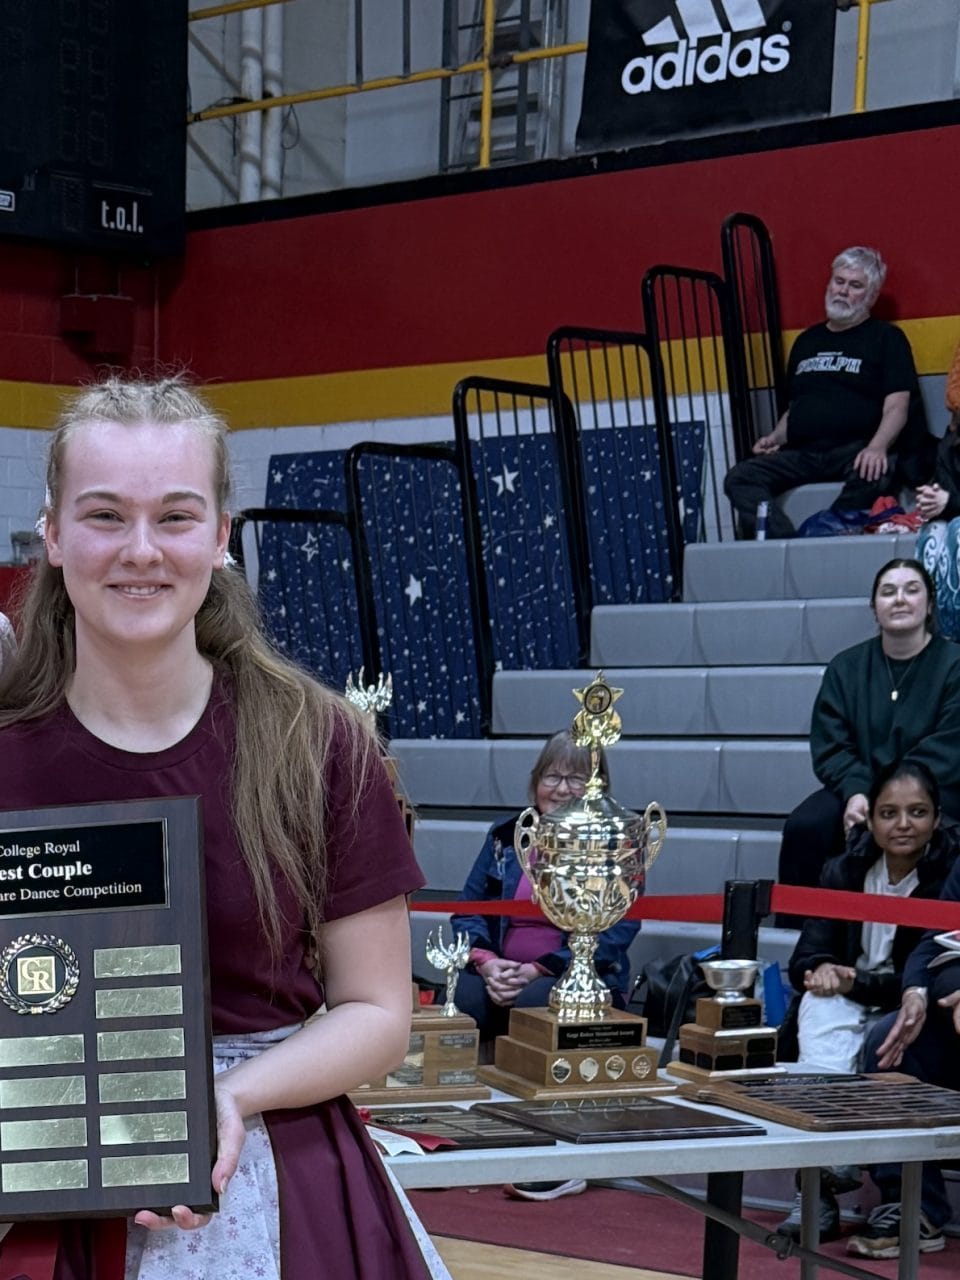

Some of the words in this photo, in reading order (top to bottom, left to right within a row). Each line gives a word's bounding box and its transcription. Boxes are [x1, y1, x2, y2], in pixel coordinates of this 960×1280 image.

[621, 31, 791, 95] adidas
[45, 840, 80, 855] Royal
[28, 861, 93, 881] Couple
[20, 887, 60, 901] Dance
[63, 882, 142, 898] Competition
